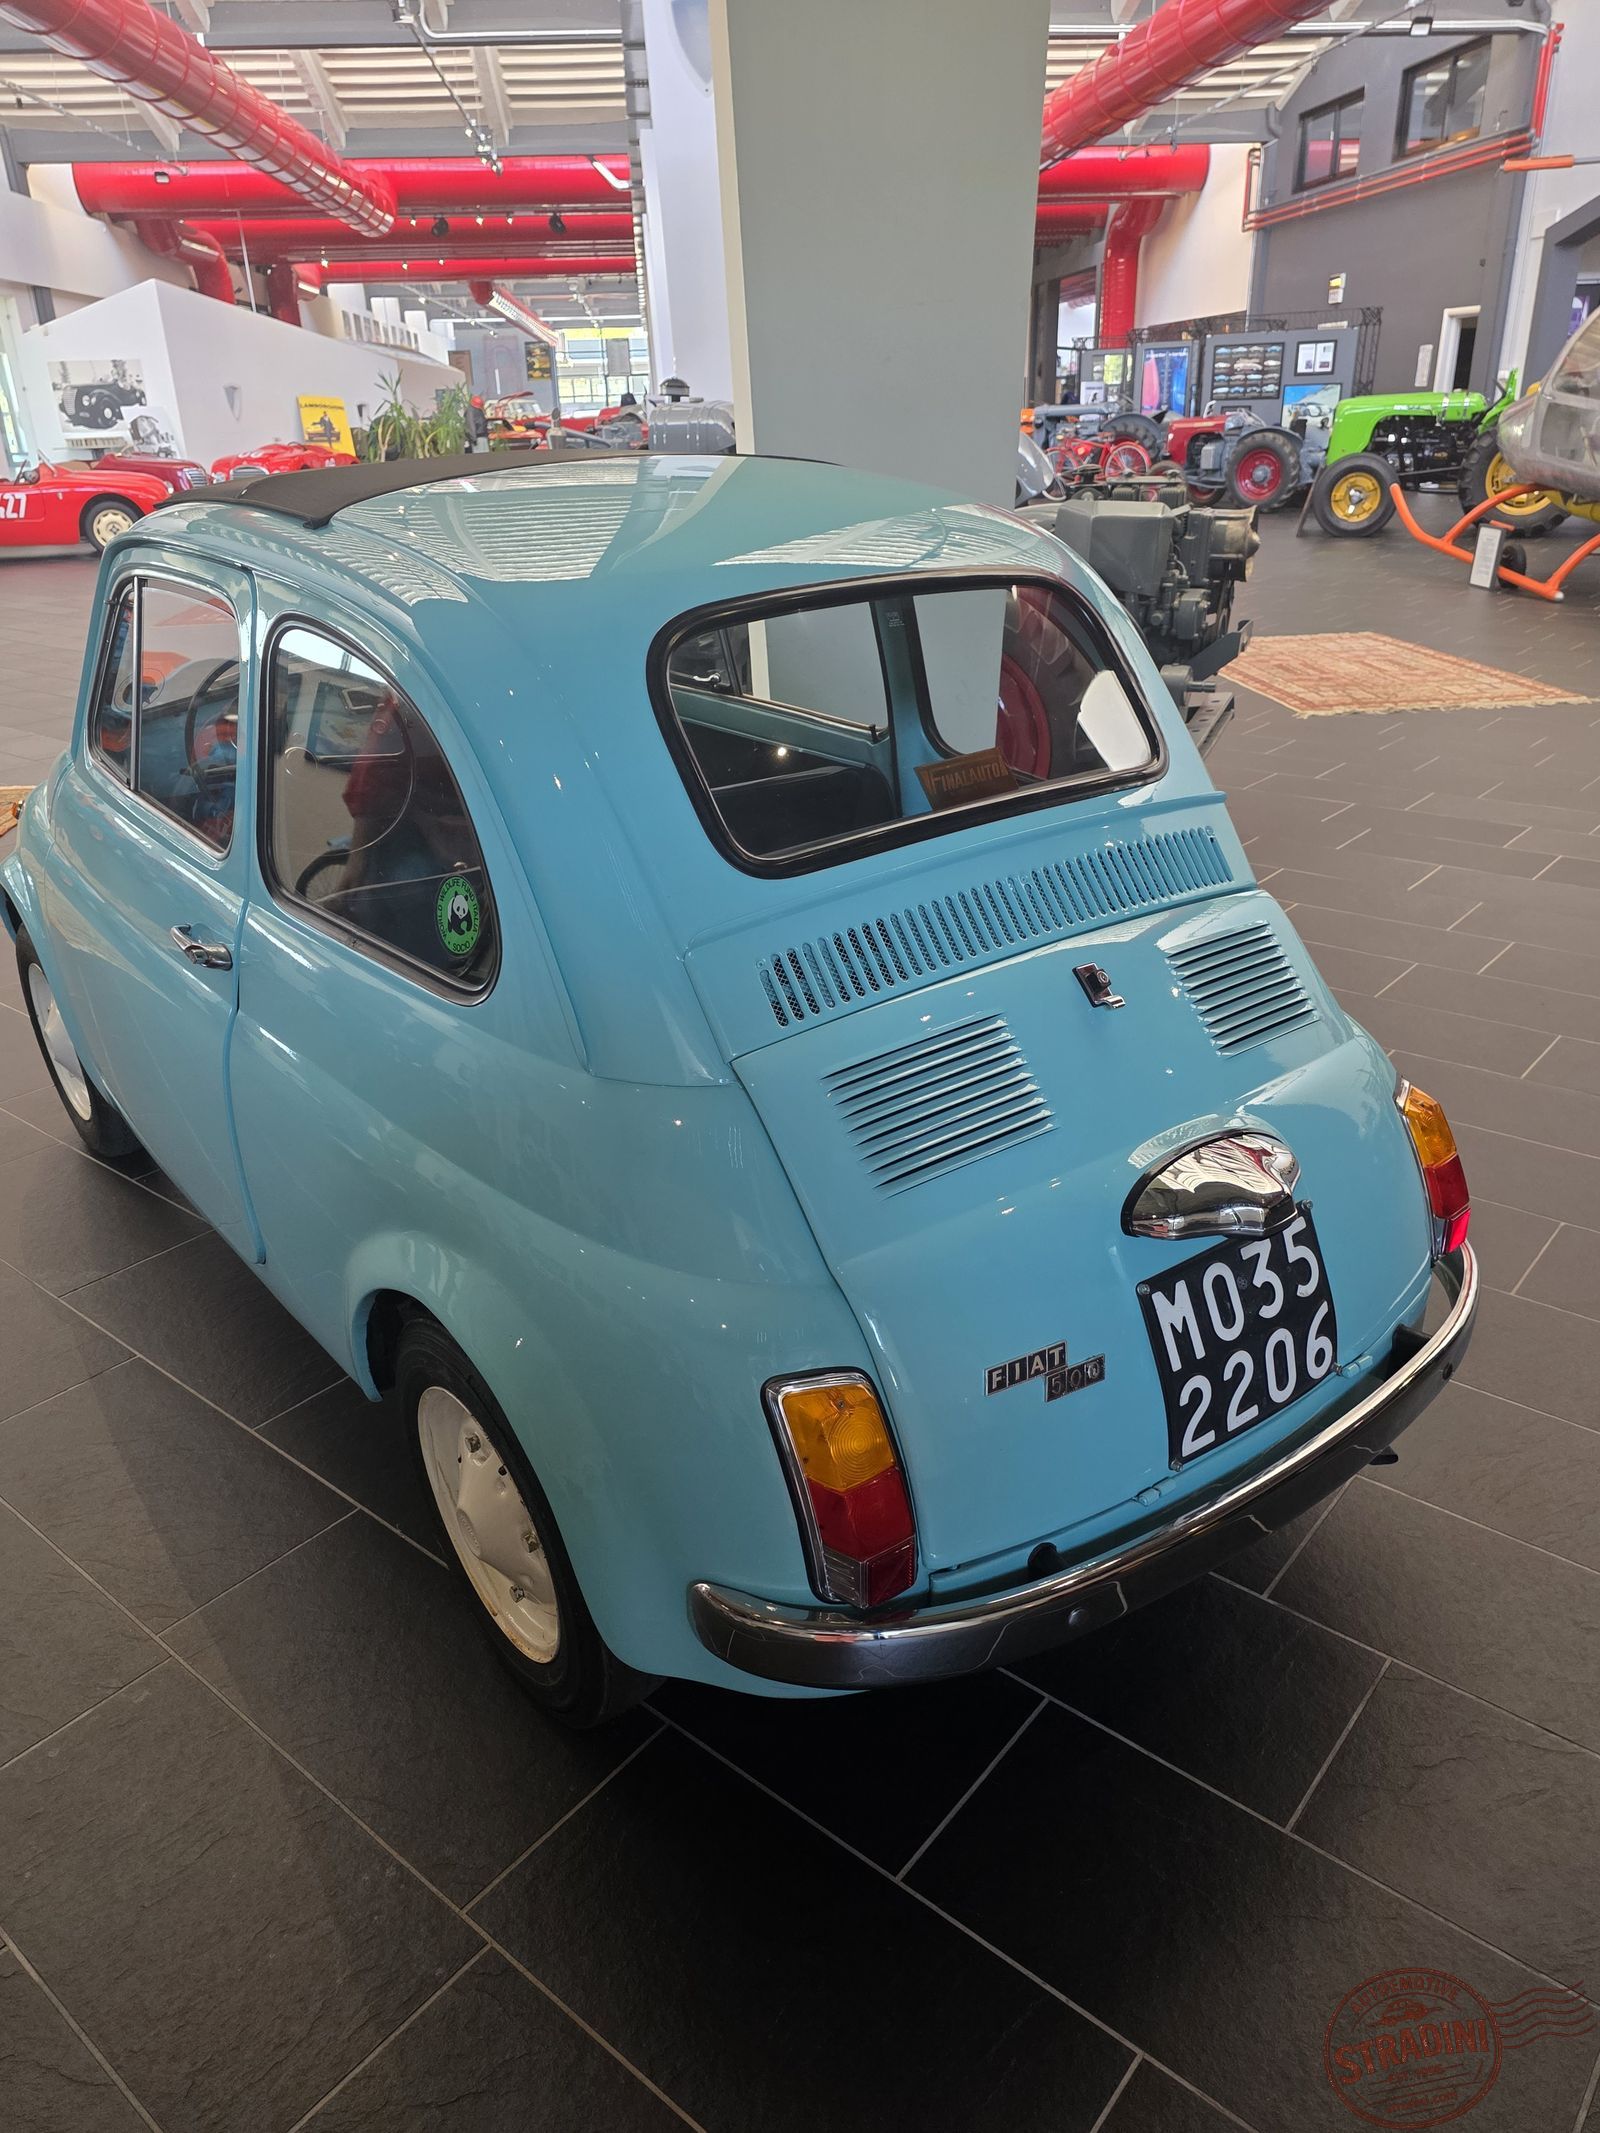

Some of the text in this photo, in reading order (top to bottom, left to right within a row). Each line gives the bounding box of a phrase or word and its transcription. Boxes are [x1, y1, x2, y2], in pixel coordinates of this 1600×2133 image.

[439, 878, 460, 901] WILDLIFE
[461, 880, 475, 902] FUND
[452, 941, 470, 952] SOCIO
[991, 1346, 1065, 1392] FIAT
[1179, 1301, 1334, 1457] 2206
